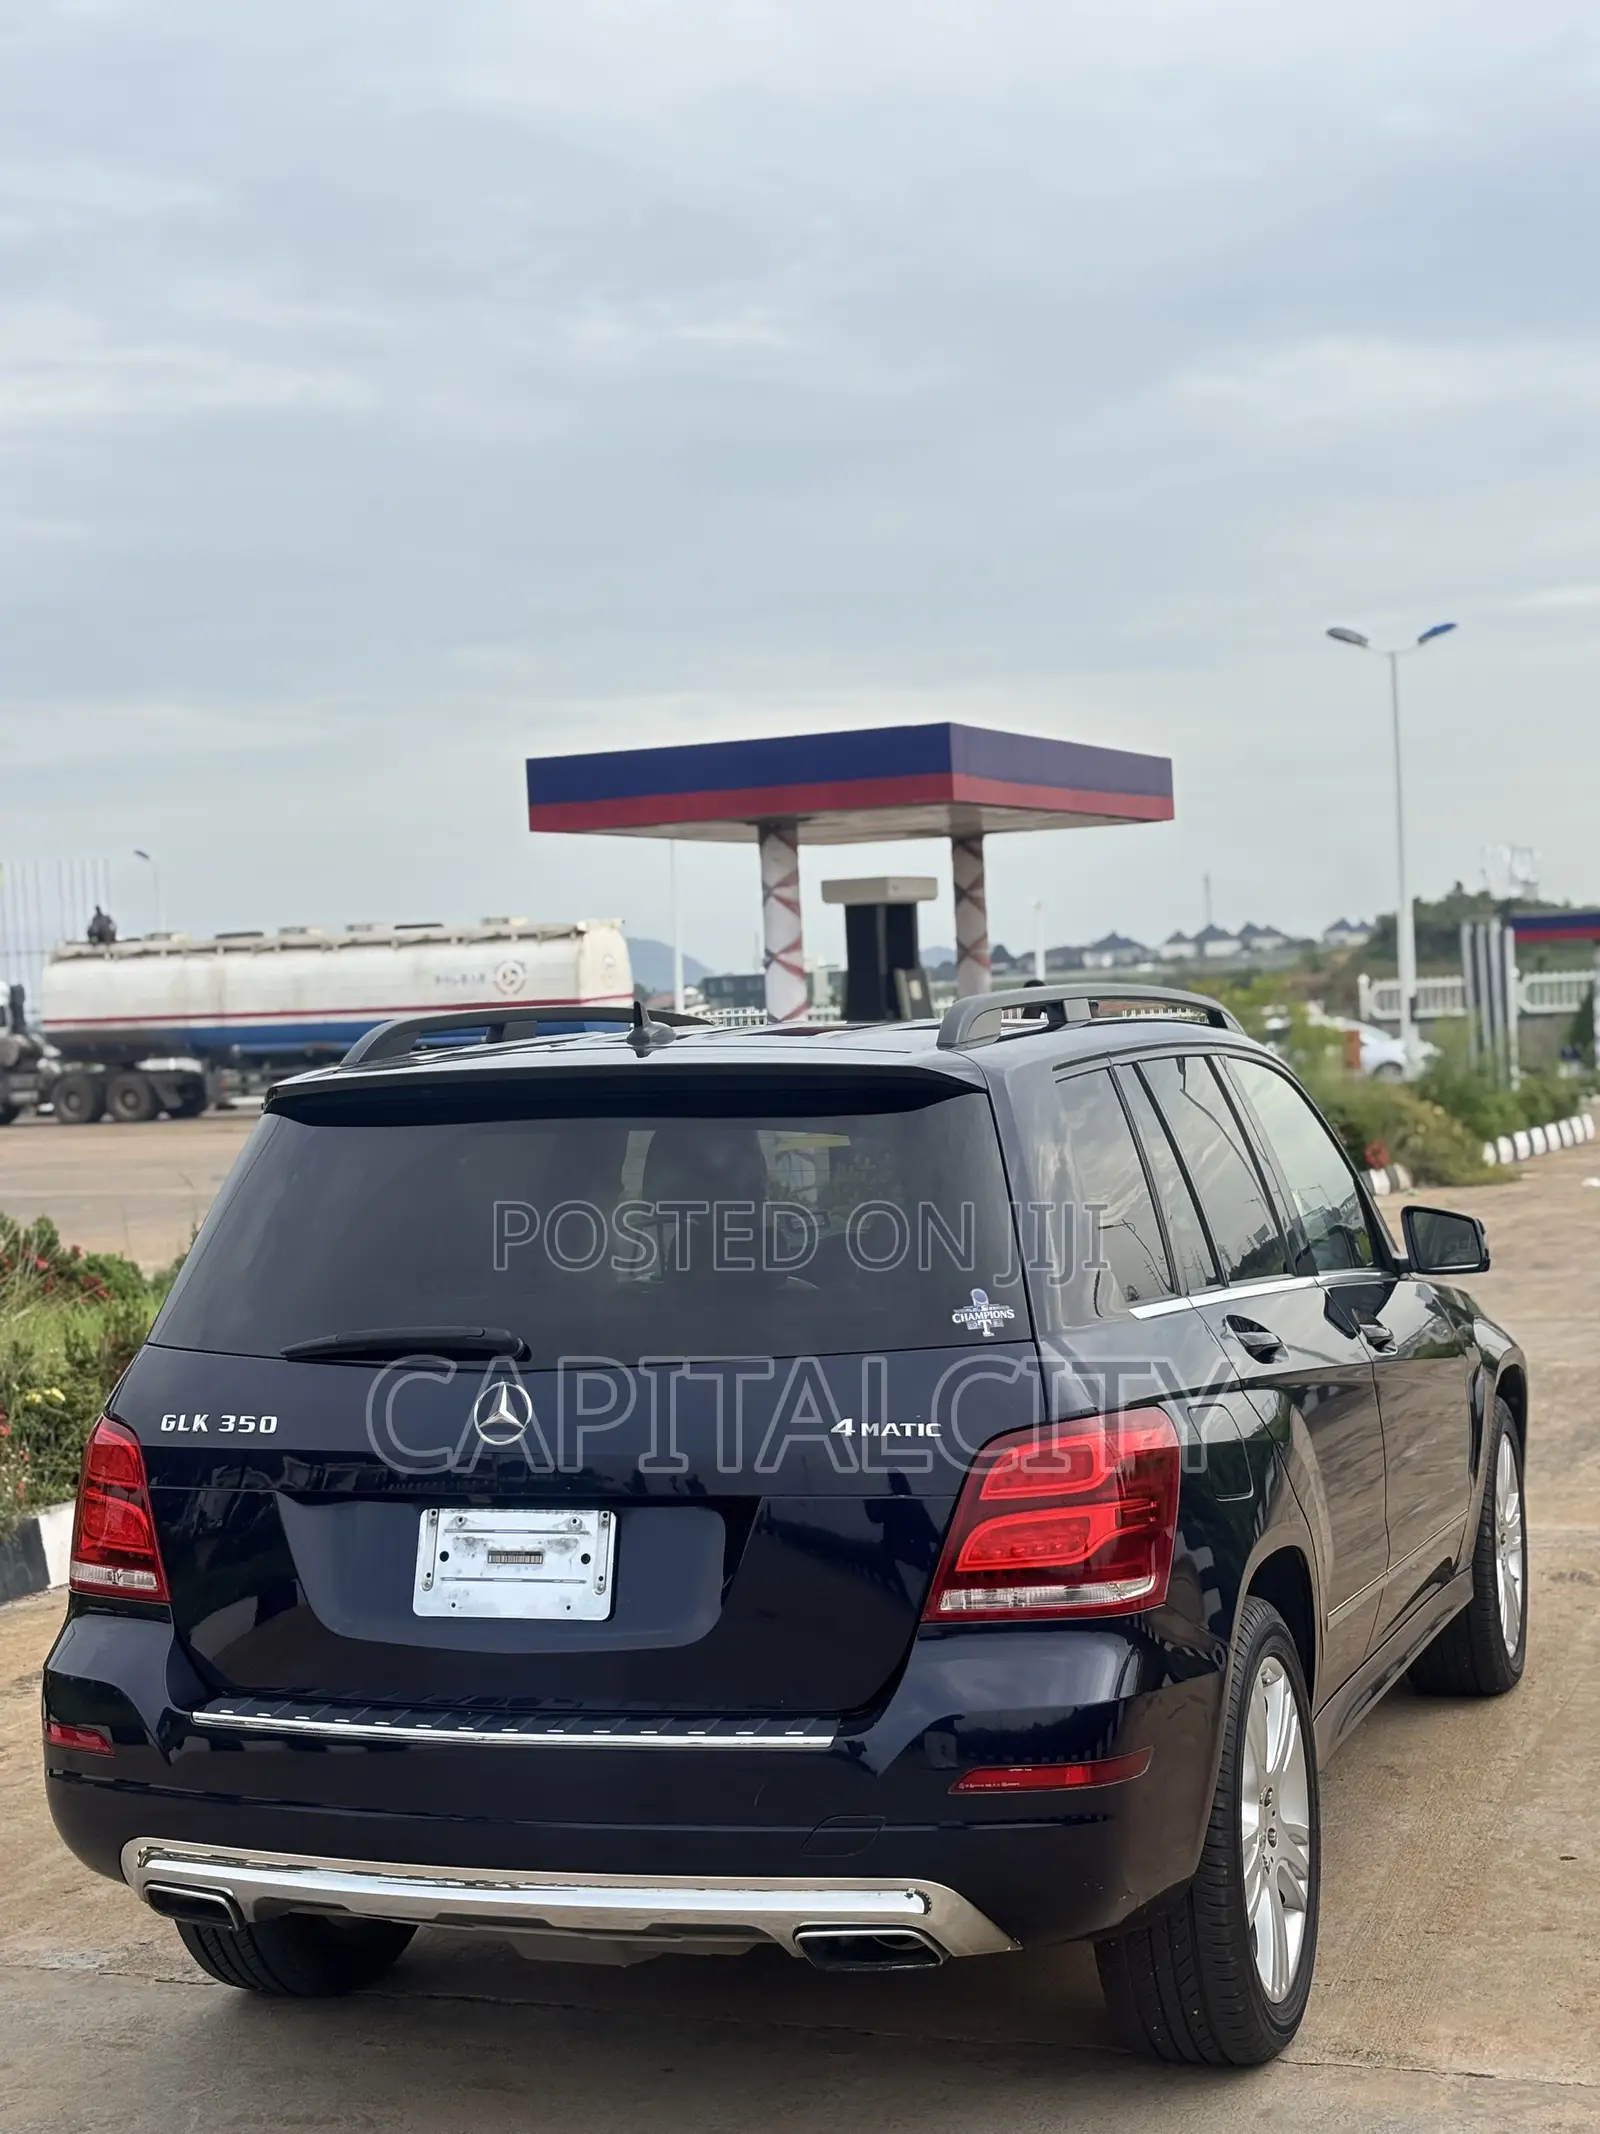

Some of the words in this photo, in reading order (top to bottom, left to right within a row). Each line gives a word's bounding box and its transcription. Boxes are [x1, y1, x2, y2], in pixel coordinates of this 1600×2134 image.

[952, 1308, 1015, 1323] CHAMPIONS
[160, 1413, 209, 1432] GLK
[218, 1414, 278, 1433] 350
[830, 1418, 855, 1436] 4
[861, 1422, 942, 1436] MATIC
